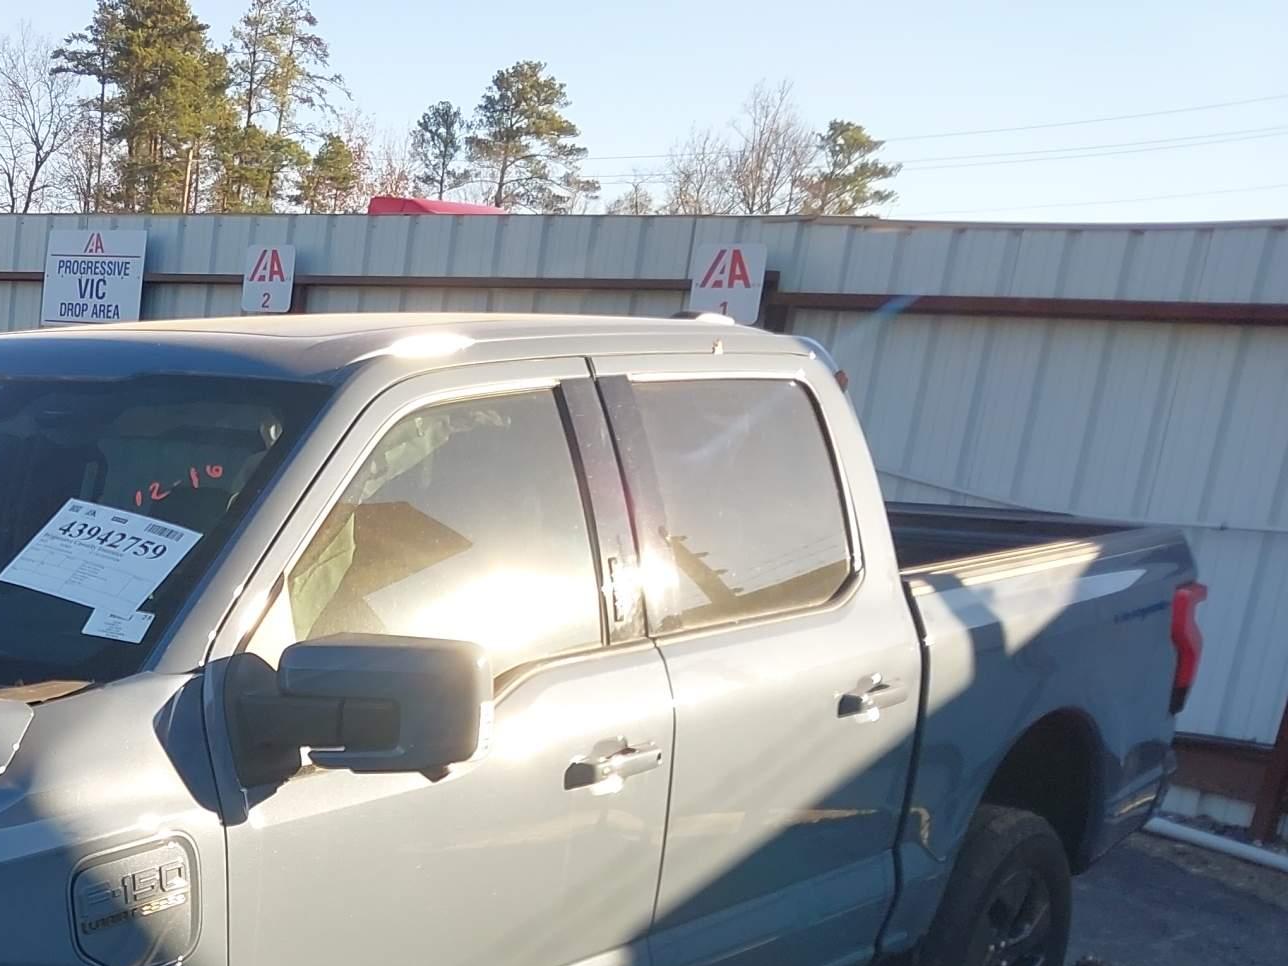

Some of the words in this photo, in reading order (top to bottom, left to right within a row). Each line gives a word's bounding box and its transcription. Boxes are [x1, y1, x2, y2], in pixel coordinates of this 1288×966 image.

[57, 259, 131, 276] PROGRESSIVE
[78, 278, 107, 300] VIC
[261, 292, 271, 308] 2
[59, 302, 89, 317] DROP
[91, 304, 120, 319] AREA
[59, 520, 168, 560] 43942759
